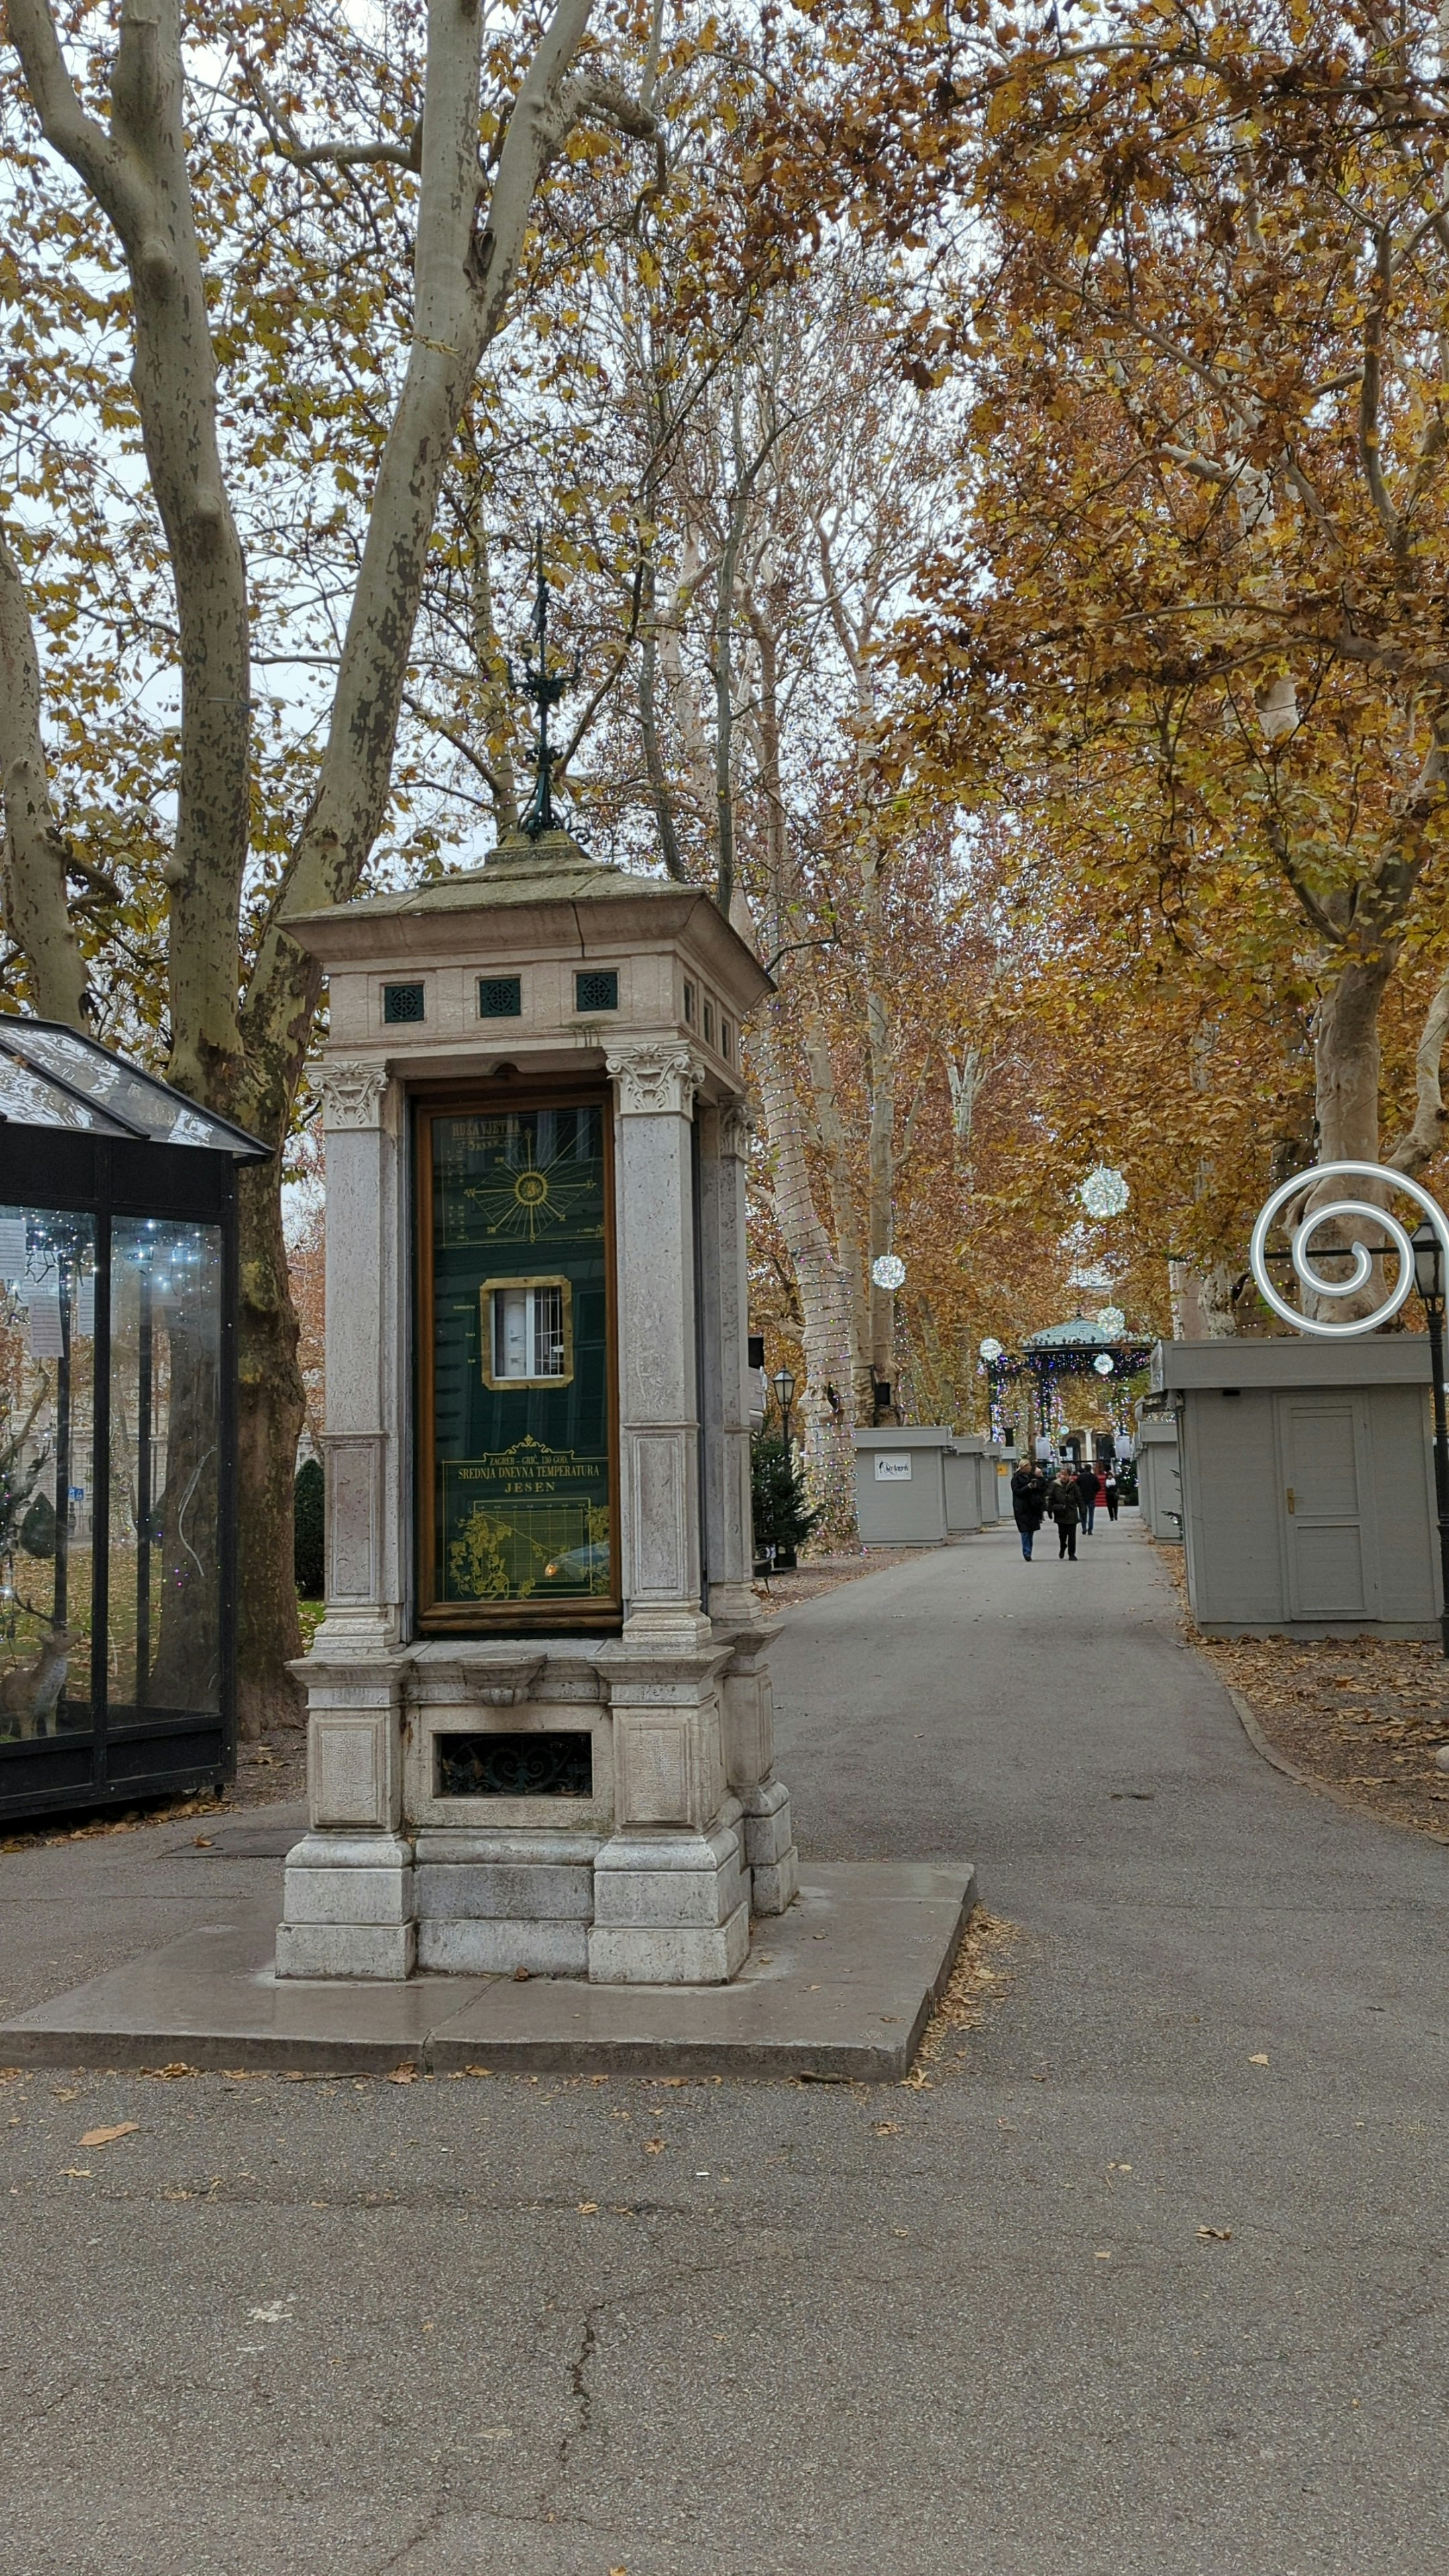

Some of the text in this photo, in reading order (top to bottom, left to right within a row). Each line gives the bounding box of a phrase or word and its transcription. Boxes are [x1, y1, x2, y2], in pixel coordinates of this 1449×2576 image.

[481, 1119, 520, 1135] VJETRA
[489, 1456, 515, 1466] ZAGREB
[553, 1456, 569, 1464] GOD.
[458, 1465, 600, 1480] SREDNJA DNEVNA TEMPERATURA
[504, 1481, 555, 1493] JESEN
